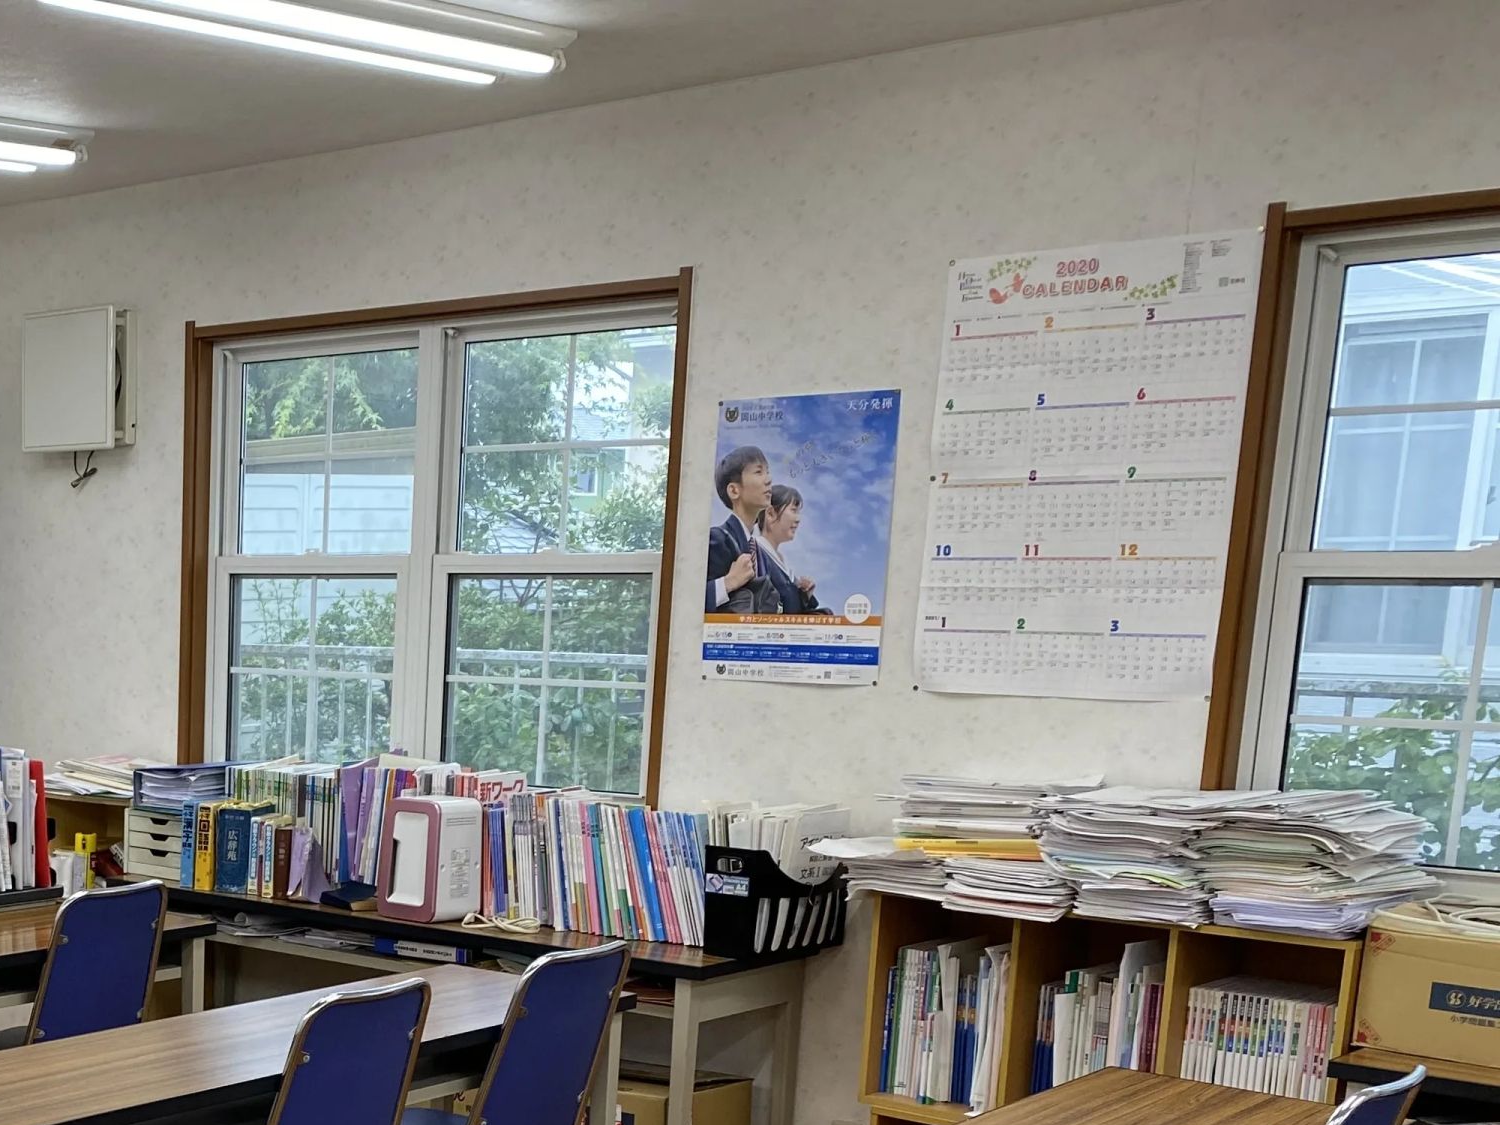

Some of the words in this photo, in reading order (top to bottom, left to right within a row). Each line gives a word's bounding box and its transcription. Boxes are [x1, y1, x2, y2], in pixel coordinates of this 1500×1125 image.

[1056, 258, 1100, 277] 2020
[1022, 275, 1129, 300] CALENDAR
[1146, 307, 1156, 321] 3
[1044, 316, 1054, 328] 2
[955, 324, 961, 337] 1
[1037, 393, 1045, 406] 5
[1137, 387, 1146, 400] 6
[847, 397, 893, 411] 天分発揮
[945, 399, 954, 410] 4
[941, 472, 949, 484] 7
[1028, 470, 1037, 481] 8
[1127, 466, 1137, 478] 9
[936, 545, 952, 556] 10
[1024, 544, 1039, 556] 11
[1120, 544, 1138, 556] 12
[941, 617, 947, 628] 1
[1016, 618, 1026, 630] 2
[1110, 620, 1120, 632] 3
[480, 779, 524, 802] 新ワーク
[227, 829, 238, 862] 広辞苑
